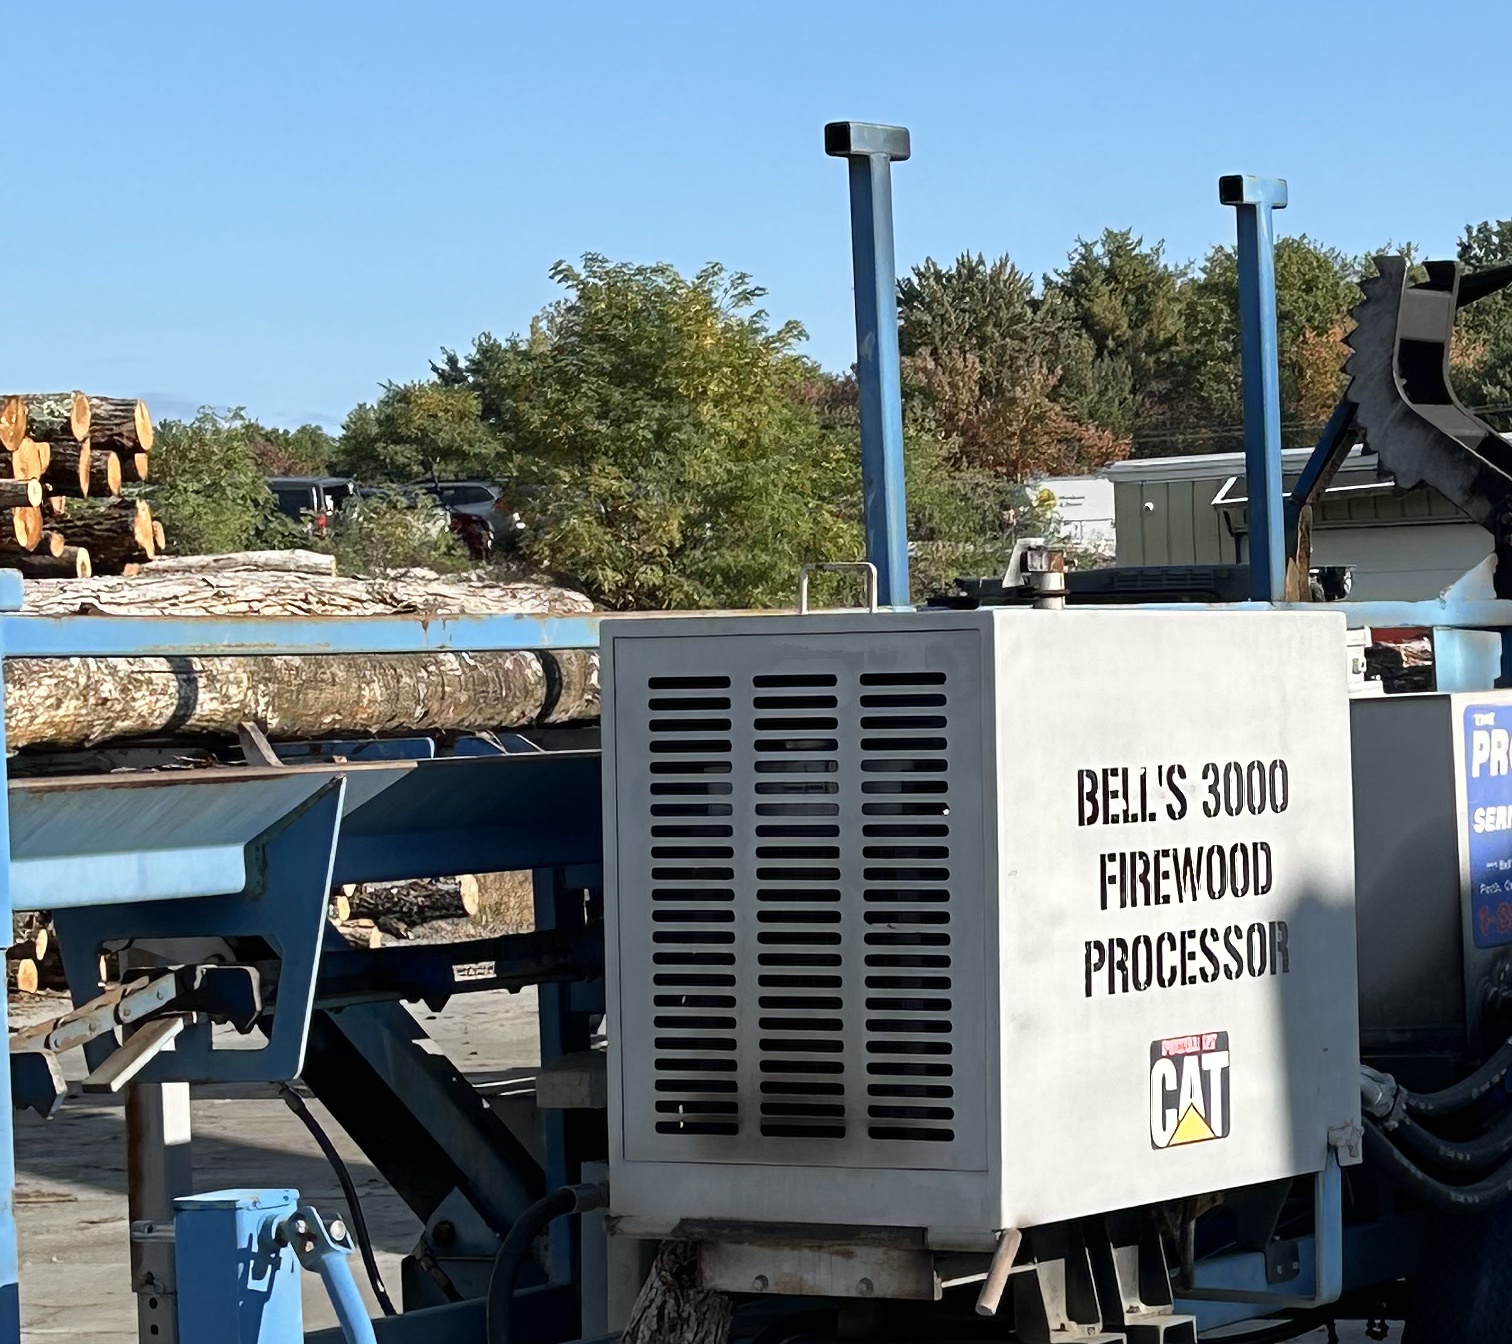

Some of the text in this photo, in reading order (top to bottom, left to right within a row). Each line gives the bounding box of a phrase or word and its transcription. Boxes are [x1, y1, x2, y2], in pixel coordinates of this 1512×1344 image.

[1078, 759, 1289, 826] BELL'S 3000
[1100, 842, 1273, 911] FIREWOOD
[1084, 921, 1290, 998] PROCESSOR
[1150, 1050, 1229, 1149] CAT
